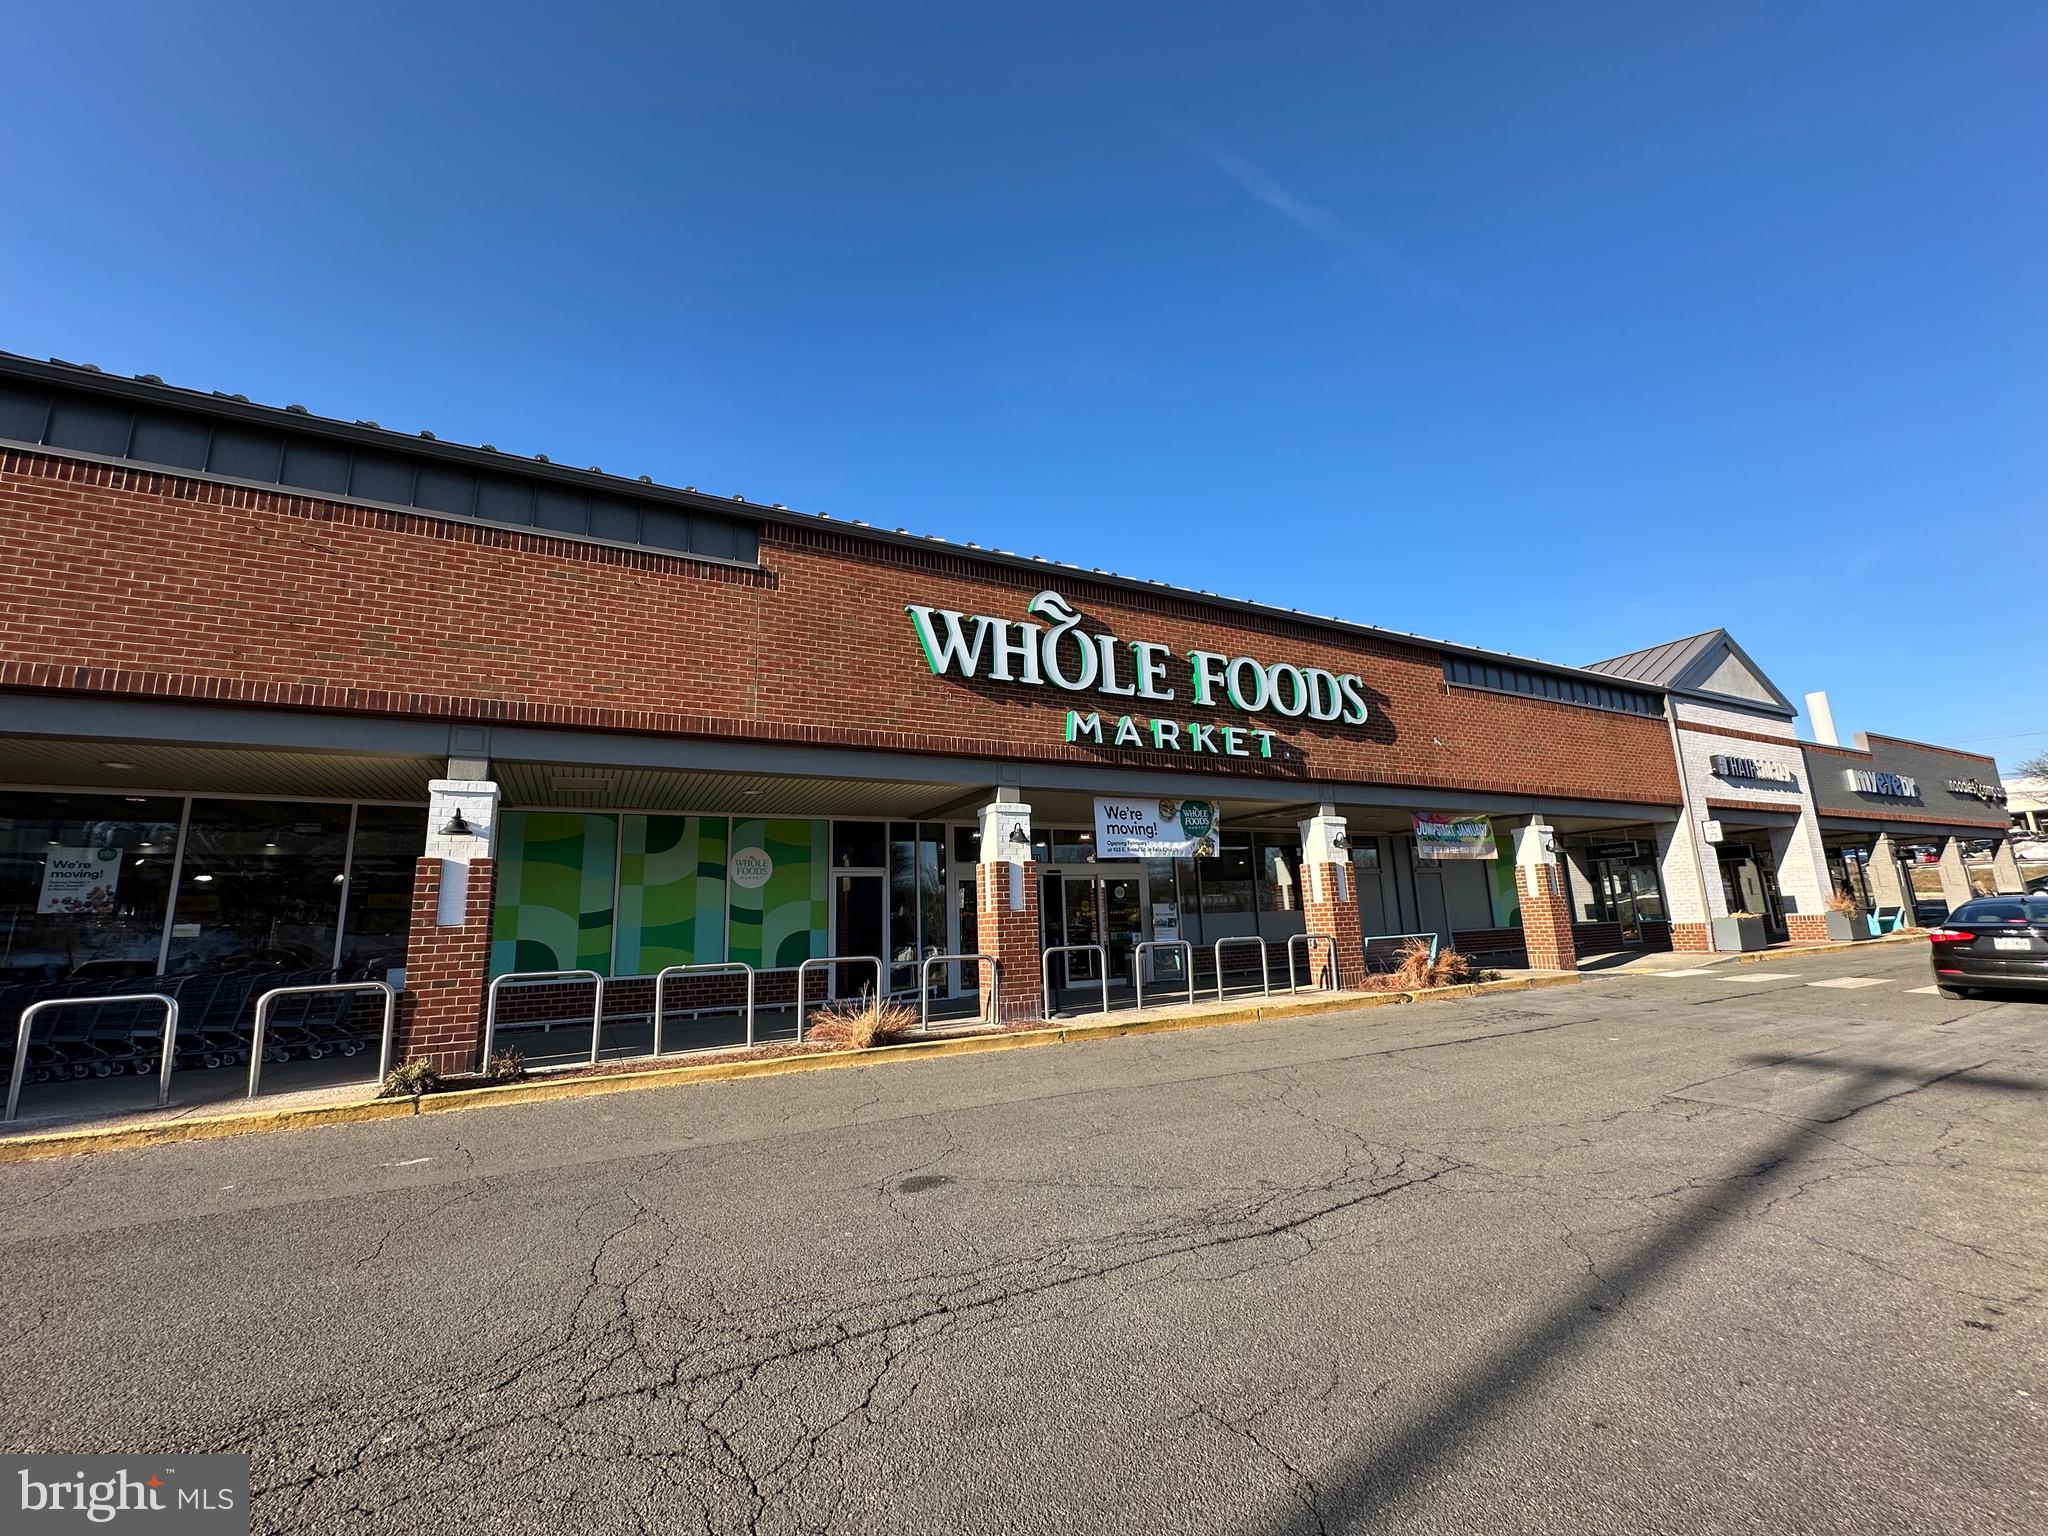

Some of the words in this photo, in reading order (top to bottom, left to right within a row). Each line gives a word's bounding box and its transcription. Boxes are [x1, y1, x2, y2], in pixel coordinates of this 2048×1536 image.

[904, 590, 1175, 701] WHOLE
[1187, 650, 1369, 726] FOODS
[1065, 710, 1276, 759] MARKET
[1104, 805, 1143, 820] We're
[1182, 807, 1208, 818] WHOLE
[1185, 817, 1210, 826] FOODS
[1106, 821, 1158, 839] moving!
[1416, 820, 1456, 837] JUMPSTART
[1456, 823, 1488, 837] JANUARY
[53, 860, 92, 869] We're
[735, 856, 769, 867] WHOLE
[50, 869, 104, 880] moving!
[736, 866, 768, 875] FOODS
